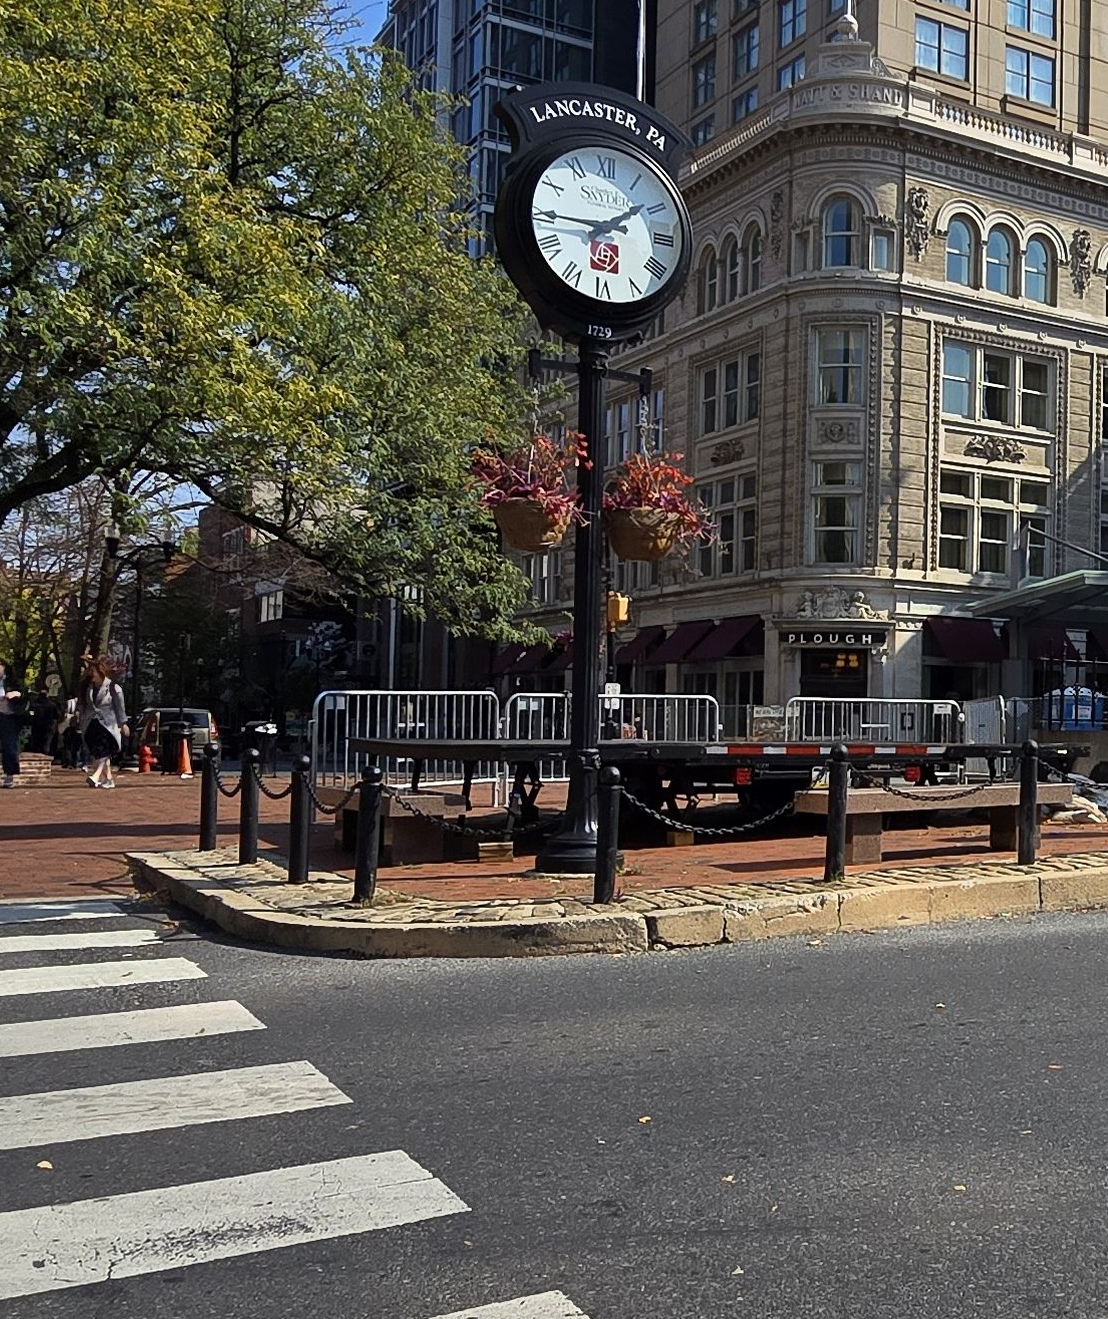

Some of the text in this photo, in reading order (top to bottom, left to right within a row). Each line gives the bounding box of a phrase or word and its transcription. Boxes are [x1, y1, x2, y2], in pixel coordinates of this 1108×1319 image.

[831, 83, 842, 99] &
[848, 83, 902, 106] SHAND
[530, 99, 668, 151] LANCASTER, PA
[564, 156, 587, 181] XI
[597, 155, 616, 180] XII
[541, 175, 565, 197] X
[580, 185, 630, 208] SNYDER
[587, 324, 612, 338] 1729
[788, 633, 872, 645] PLOUGH
